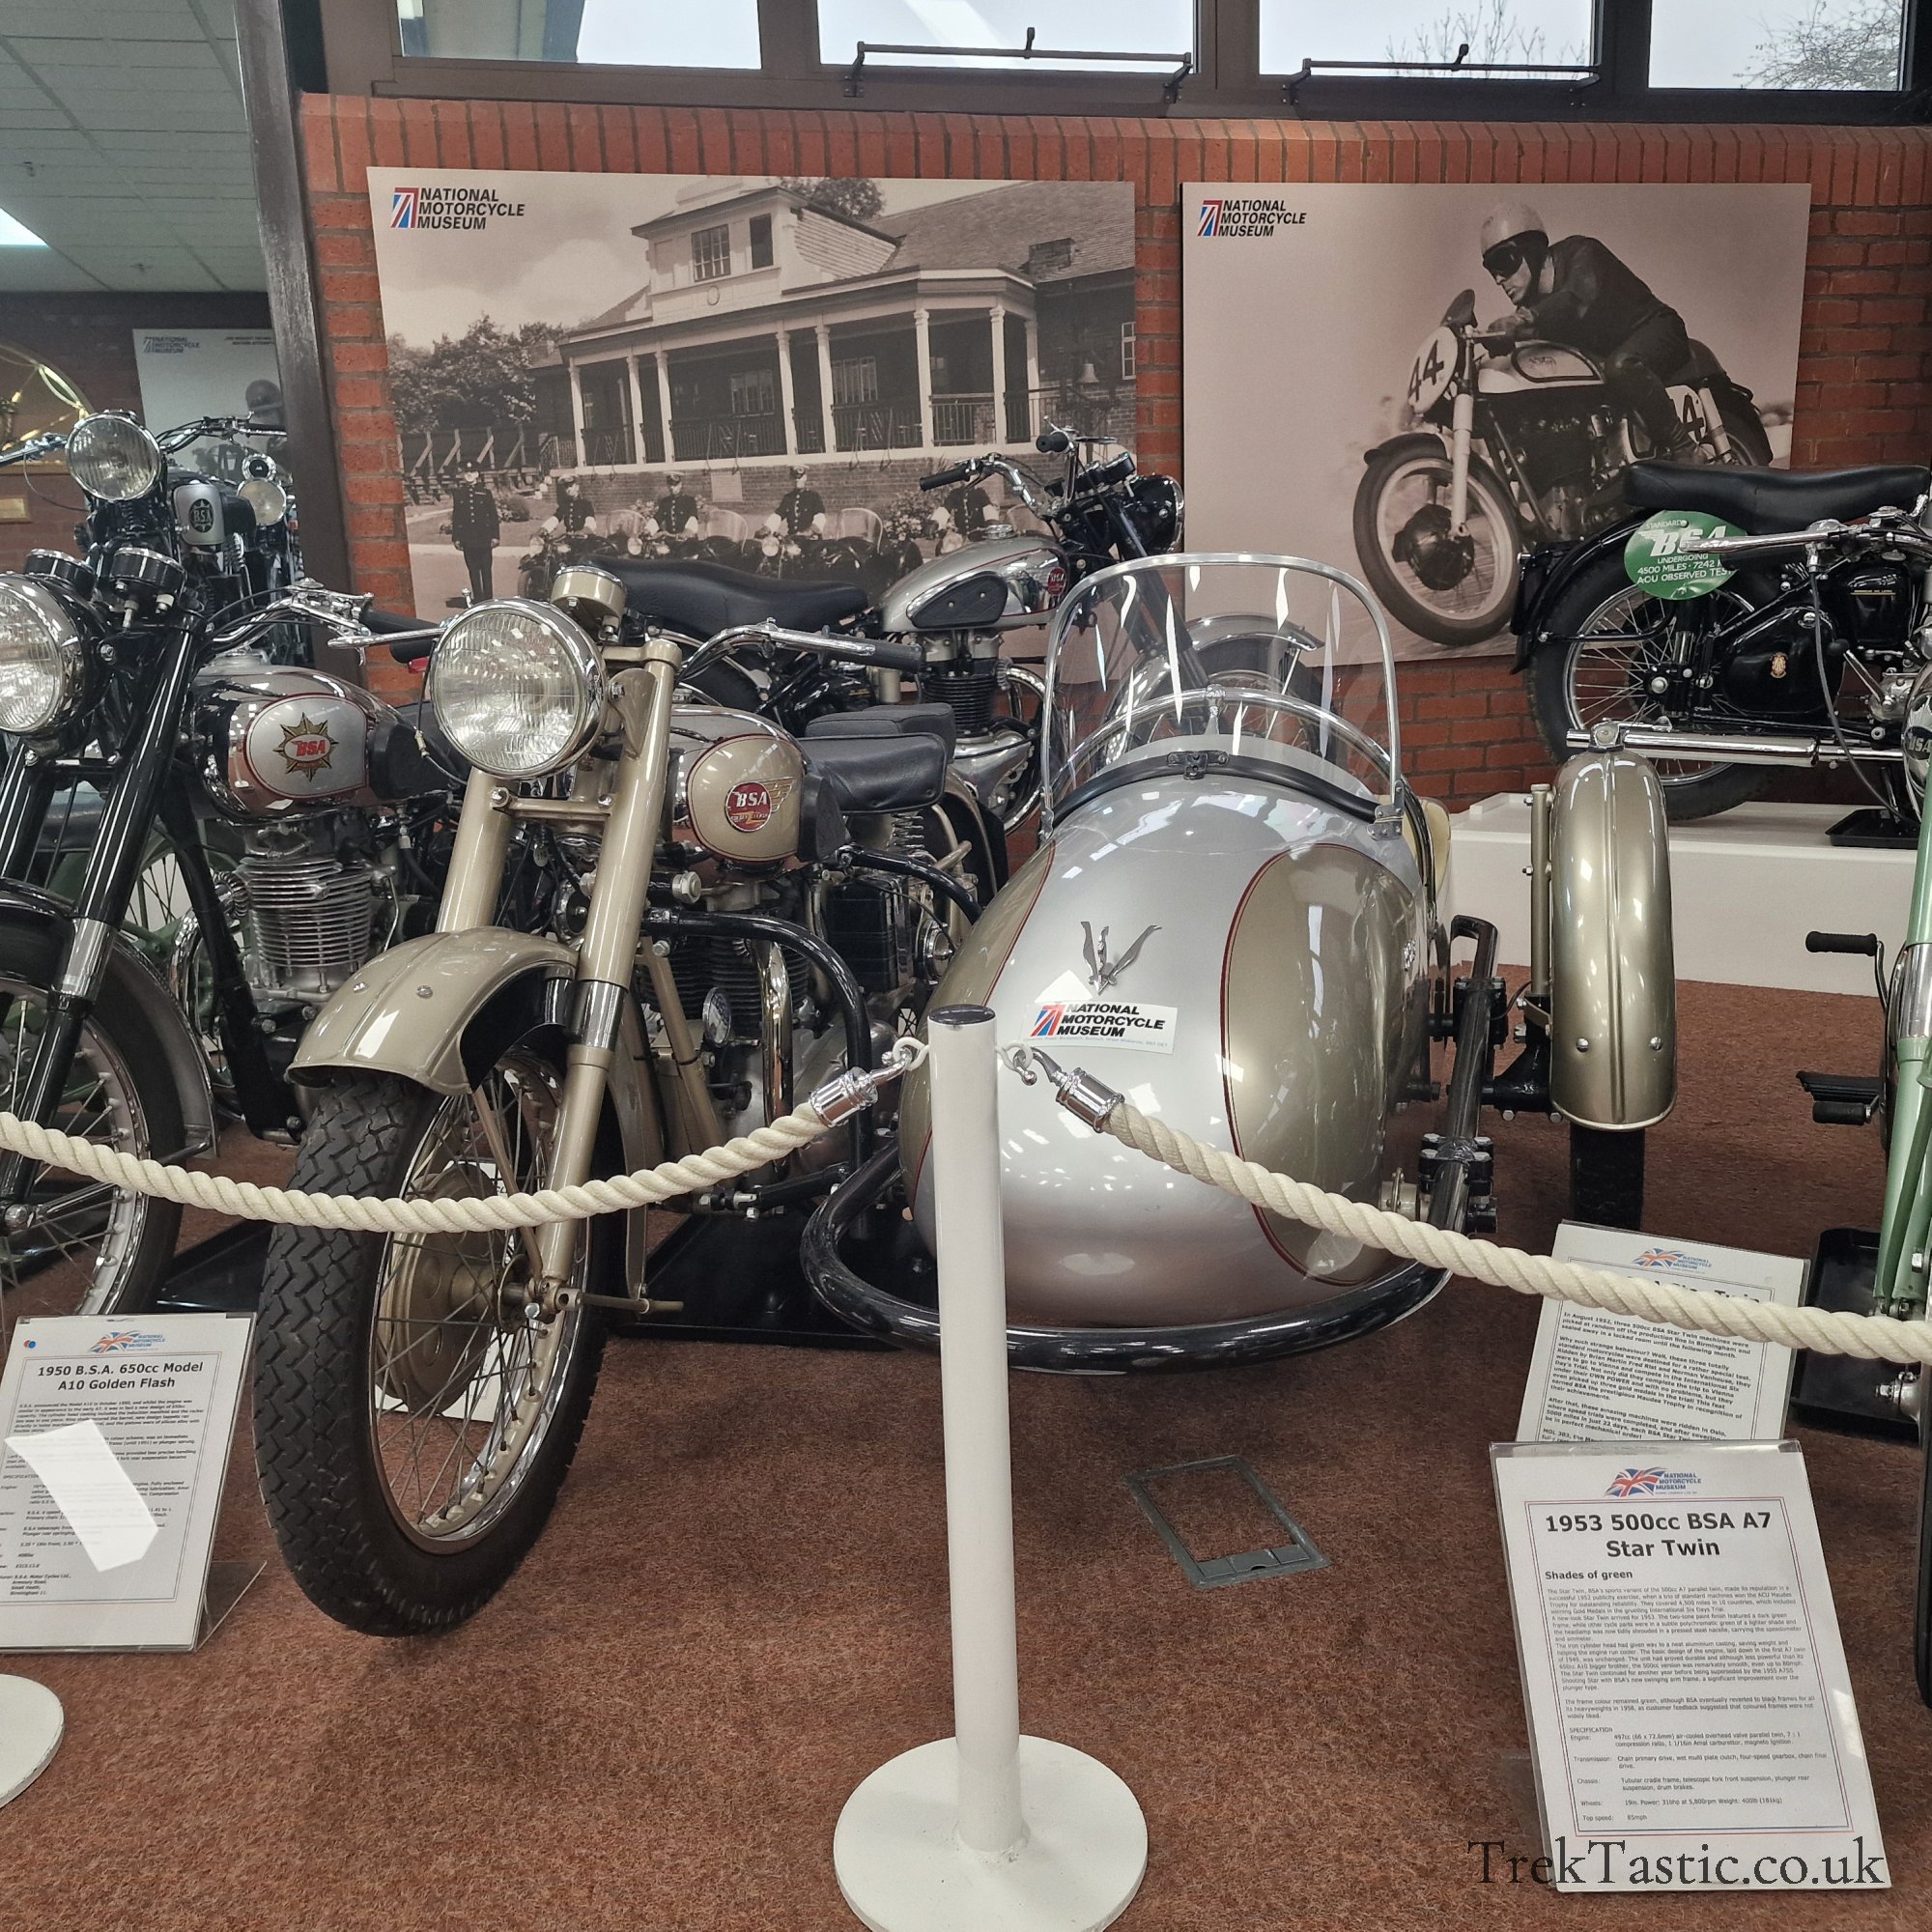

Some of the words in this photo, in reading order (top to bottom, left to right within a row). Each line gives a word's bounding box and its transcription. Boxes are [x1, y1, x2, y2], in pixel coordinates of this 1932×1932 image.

[420, 187, 499, 202] NATIONAL
[418, 202, 526, 216] MOTORCYCLE
[1223, 200, 1287, 212] NATIONAL
[416, 215, 487, 230] MUSEUM
[1220, 213, 1307, 224] MOTORCYCLE
[1218, 225, 1274, 237] MUSEUM
[1407, 339, 1444, 402] 44
[193, 508, 213, 523] BSA
[1658, 554, 1709, 564] UNDERGOING
[1662, 562, 1687, 572] MILES
[1693, 559, 1715, 569] 7242
[1636, 576, 1659, 584] ACU
[1662, 570, 1707, 581] OBSERVED
[294, 740, 326, 756] BSA
[733, 791, 768, 808] BSA
[1065, 1004, 1140, 1015] NATIONAL
[1061, 1014, 1166, 1030] MOTORCYCLE
[1057, 1026, 1125, 1037] MUSEUM
[1562, 1318, 1583, 1326] picked
[1591, 1322, 1616, 1331] random
[1638, 1331, 1674, 1342] production
[1674, 1336, 1688, 1345] line
[1695, 1340, 1737, 1352] Birmingham
[1571, 1313, 1594, 1321] August
[1595, 1317, 1613, 1325] 1952,
[1613, 1320, 1632, 1328] three
[1632, 1322, 1651, 1331] 500cc
[1682, 1331, 1698, 1340] Twin
[1698, 1335, 1731, 1346] machines
[1581, 1327, 1600, 1336] away
[1612, 1331, 1634, 1341] locked
[1681, 1344, 1713, 1356] following
[1713, 1350, 1738, 1359] month.
[1559, 1335, 1574, 1344] Why
[1589, 1341, 1614, 1350] strange
[1614, 1345, 1651, 1356] behaviour?
[1651, 1351, 1668, 1360] Well,
[1668, 1354, 1688, 1364] these
[1688, 1358, 1707, 1367] three
[1707, 1361, 1730, 1372] totally
[37, 1365, 72, 1377] 1950
[74, 1364, 114, 1376] B.S.A.
[119, 1363, 159, 1375] 650cc
[162, 1361, 204, 1374] Model
[1557, 1342, 1586, 1351] standard
[1586, 1347, 1625, 1358] motorcycles
[1642, 1356, 1671, 1367] destined
[1688, 1365, 1710, 1374] rather
[1710, 1369, 1735, 1378] special
[1735, 1373, 1751, 1382] test.
[57, 1379, 85, 1391] A10
[88, 1378, 136, 1390] Golden
[139, 1377, 176, 1388] Flash
[1546, 1514, 1604, 1533] 1953
[1610, 1513, 1681, 1531] 500cc
[1686, 1512, 1736, 1530] BSA
[1743, 1511, 1772, 1529] A7
[1605, 1540, 1656, 1558] Star
[1661, 1538, 1720, 1556] Twin
[1545, 1570, 1585, 1580] Shades
[1587, 1570, 1598, 1579] of
[1601, 1571, 1634, 1581] green
